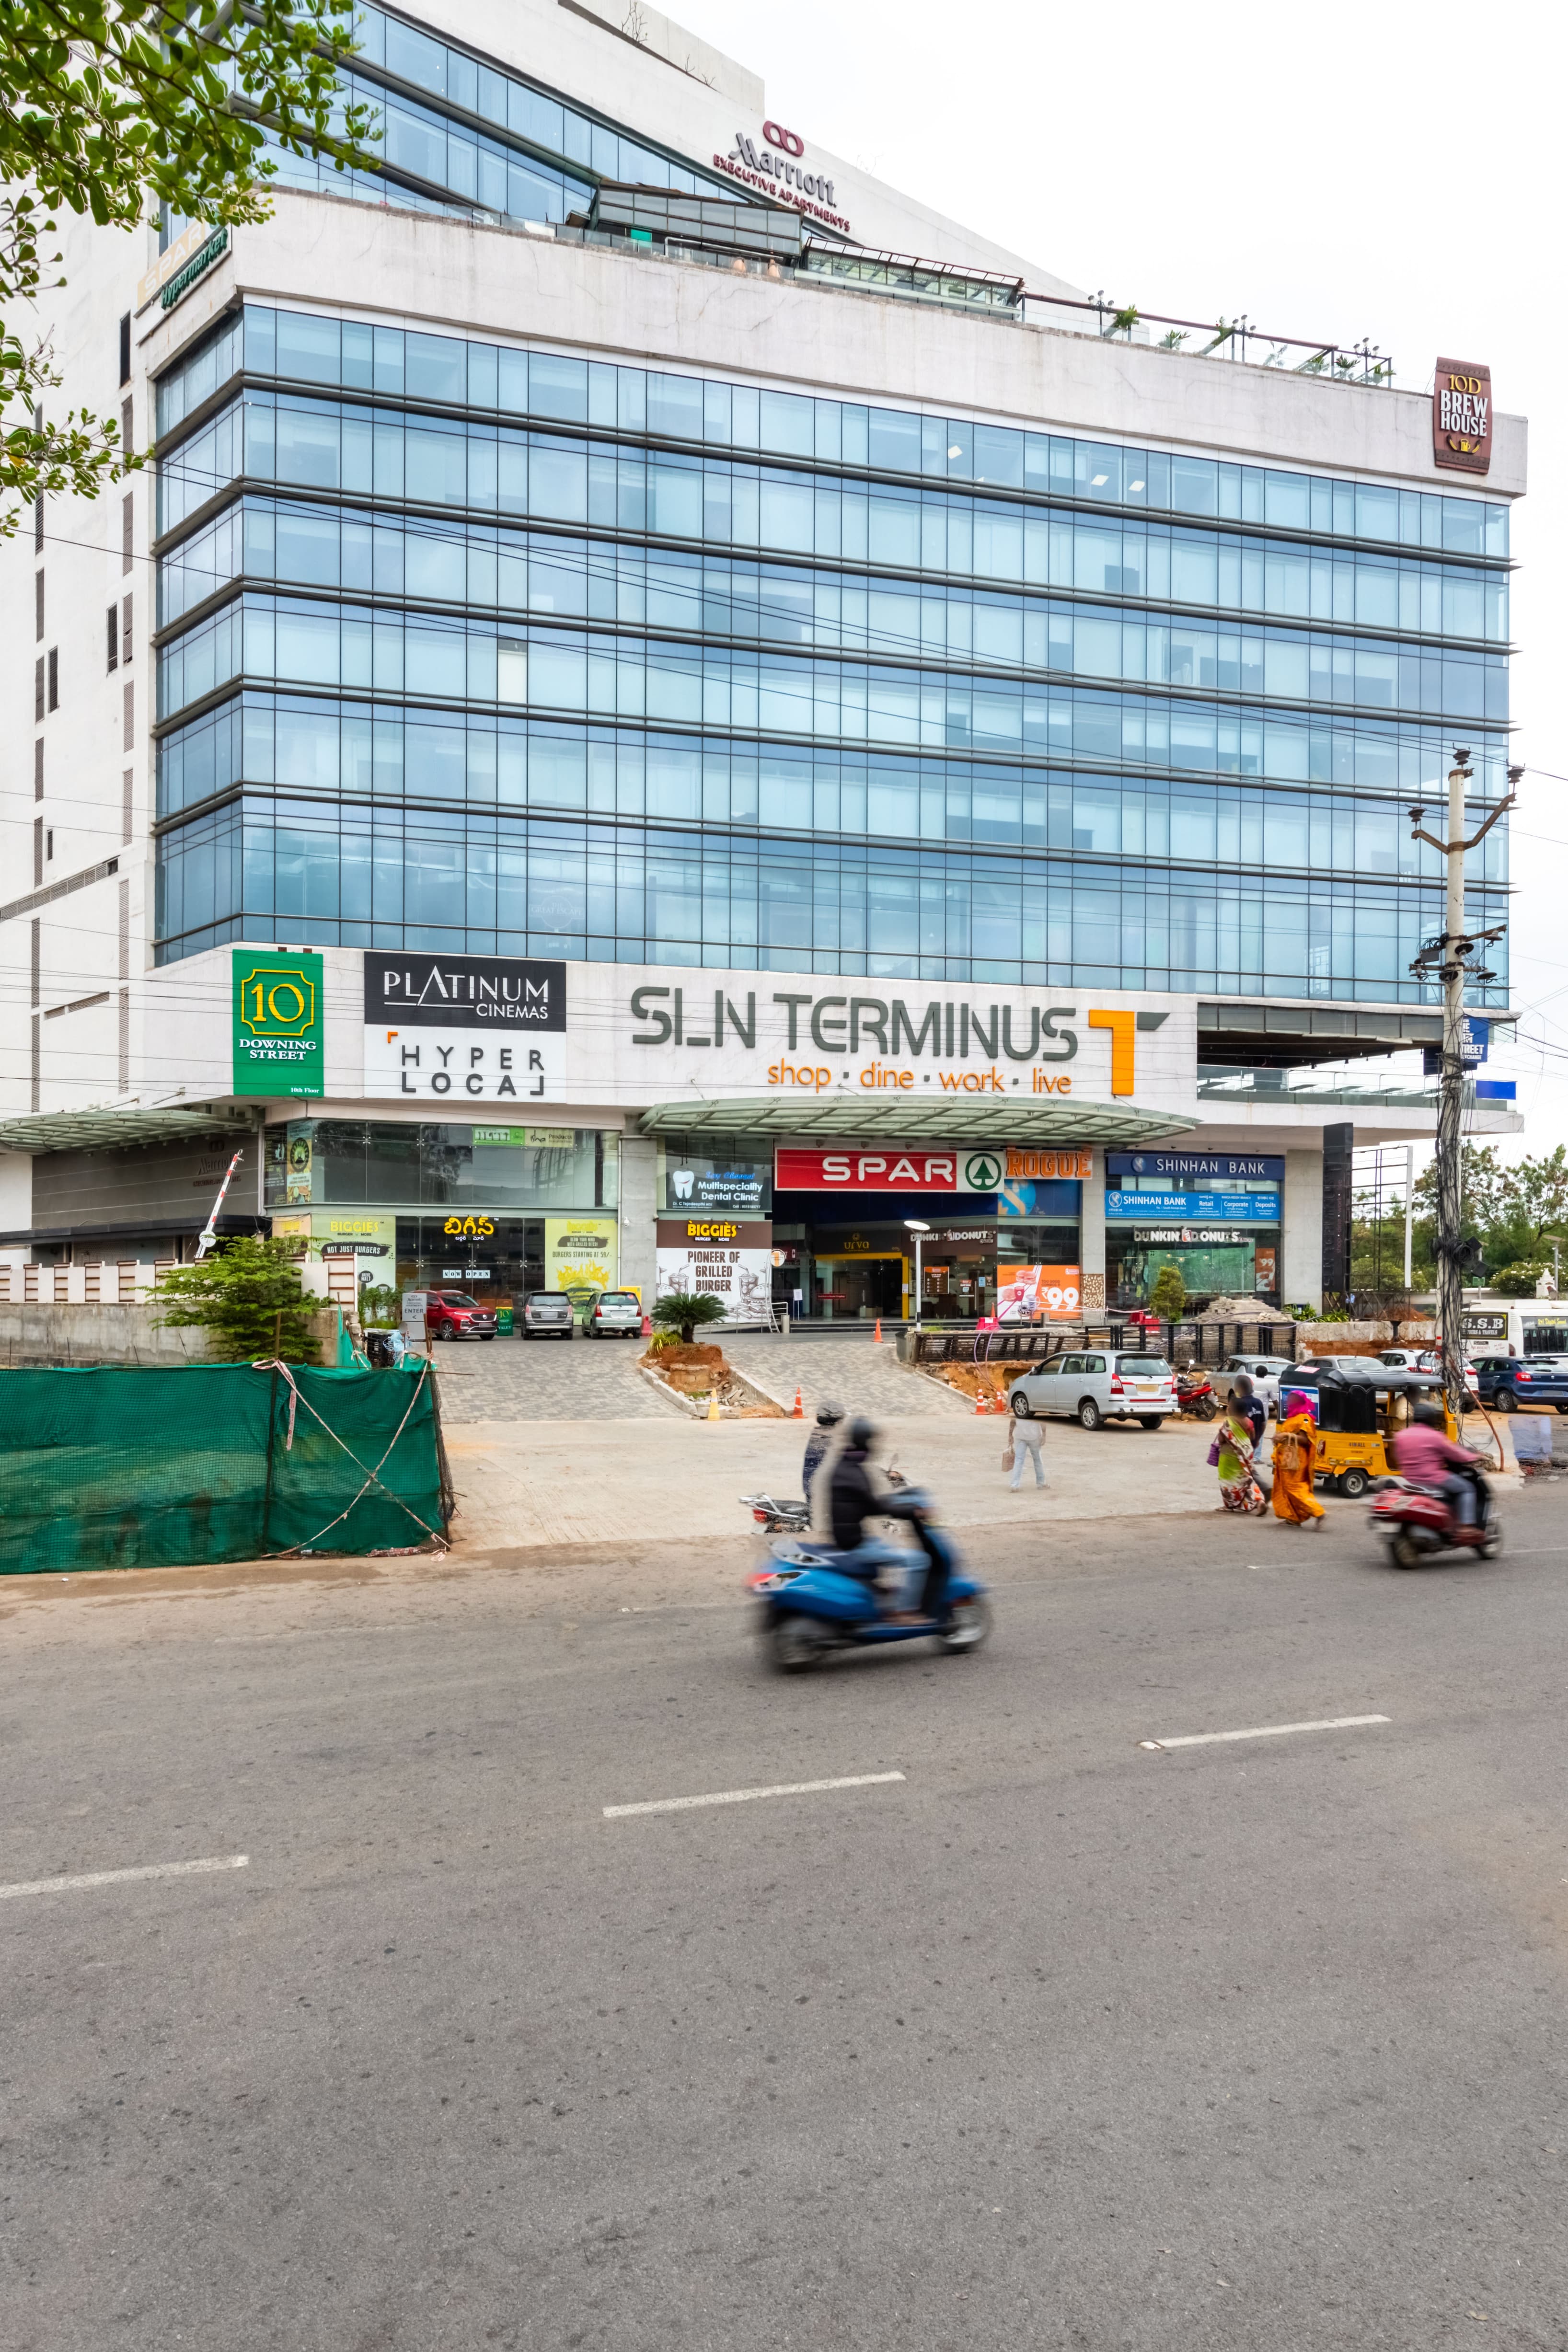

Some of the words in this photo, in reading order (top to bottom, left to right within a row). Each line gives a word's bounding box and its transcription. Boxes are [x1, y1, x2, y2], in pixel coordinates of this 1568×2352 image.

[728, 132, 836, 207] Marriott
[714, 154, 776, 196] EXECUTIVE
[778, 187, 851, 232] APARTMENTS
[161, 228, 228, 310] Hypermarket
[1449, 374, 1481, 394] 10D
[1441, 389, 1488, 418] BREW
[1441, 411, 1487, 437] HOUSE
[384, 965, 548, 1004] PLATINUM
[251, 983, 305, 1022] 10
[476, 1003, 548, 1020] CINEMAS
[631, 986, 755, 1049] SLN
[773, 993, 1078, 1061] TERMINUS
[239, 1039, 316, 1050] DOWNING
[250, 1050, 306, 1060] STREET
[1462, 1045, 1484, 1054] TREET
[402, 1045, 544, 1071] HYPER
[767, 1058, 831, 1094] shop
[860, 1062, 914, 1090] dine
[939, 1066, 1004, 1093] work
[1033, 1068, 1072, 1094] live
[822, 1156, 953, 1183] SPAR
[1006, 1152, 1092, 1178] ROGUE
[1157, 1159, 1218, 1173] SHINHAN
[1229, 1161, 1265, 1175] BANK
[698, 1182, 762, 1192] Multispeciality
[702, 1192, 731, 1200] Dental
[733, 1193, 759, 1201] Clinic
[1123, 1196, 1162, 1204] SHINHAN
[688, 1251, 726, 1263] PIONEER
[729, 1251, 740, 1263] OF
[696, 1265, 732, 1277] GRILLED
[696, 1280, 731, 1291] BURGER
